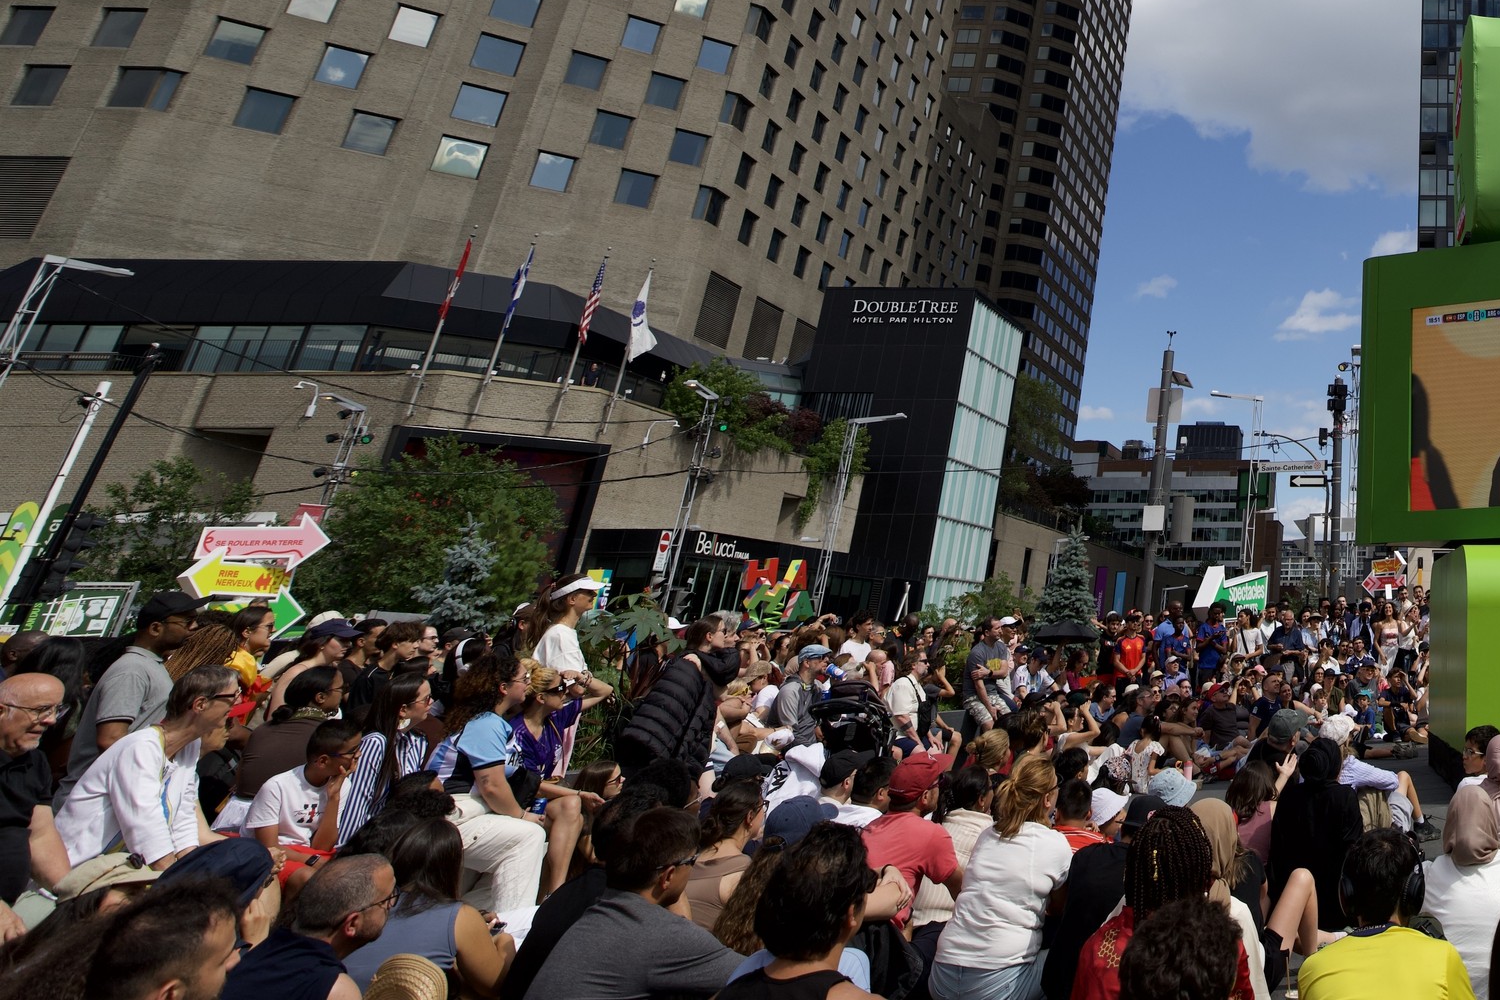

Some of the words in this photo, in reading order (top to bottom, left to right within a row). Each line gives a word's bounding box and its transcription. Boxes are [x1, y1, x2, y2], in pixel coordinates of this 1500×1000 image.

[853, 316, 884, 324] HÔTEL
[1261, 464, 1313, 472] Sainte-Catherine
[695, 531, 737, 558] Bellucci
[734, 551, 750, 560] ITALIA
[218, 569, 240, 578] RIRE
[215, 579, 254, 588] NERVEUX
